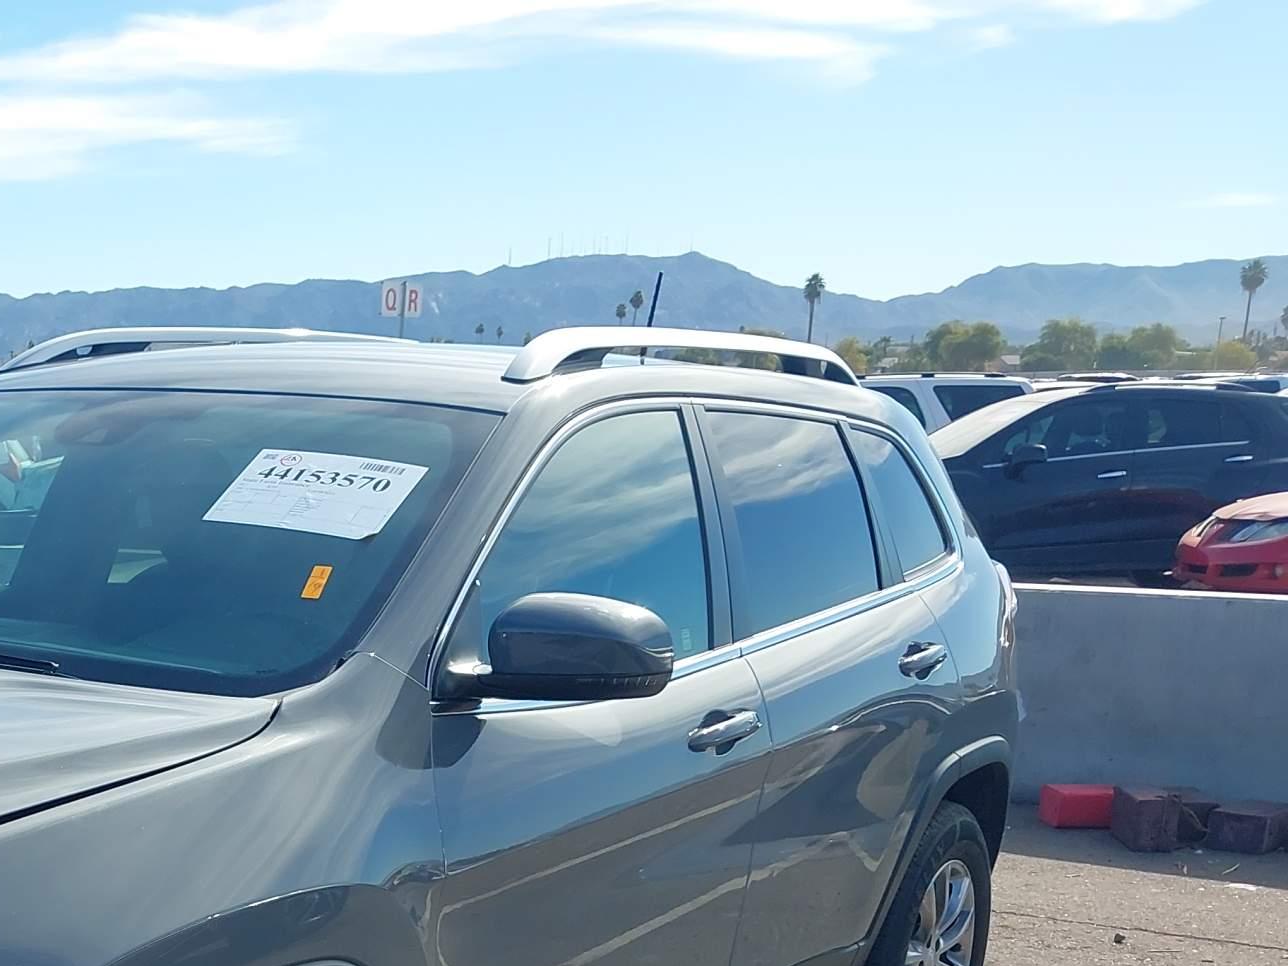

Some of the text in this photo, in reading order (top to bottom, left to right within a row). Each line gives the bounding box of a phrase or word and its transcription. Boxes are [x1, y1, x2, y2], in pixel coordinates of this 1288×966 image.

[385, 288, 418, 312] Q R
[257, 465, 391, 493] 44153570
